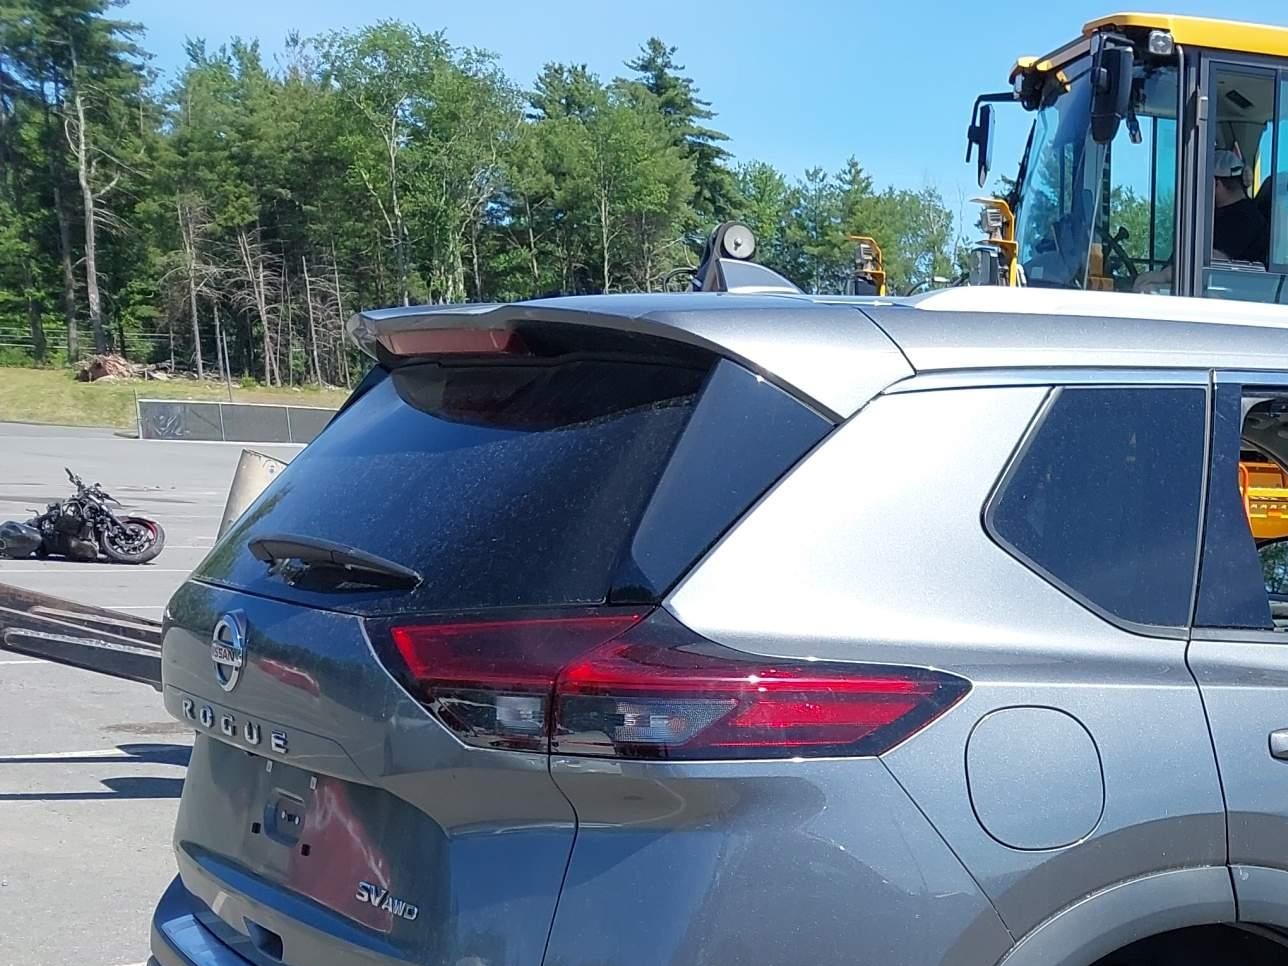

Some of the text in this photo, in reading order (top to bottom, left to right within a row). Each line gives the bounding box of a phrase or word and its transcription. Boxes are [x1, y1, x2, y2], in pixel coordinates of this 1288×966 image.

[182, 698, 290, 755] ROGUE
[355, 880, 419, 921] SV AWD
